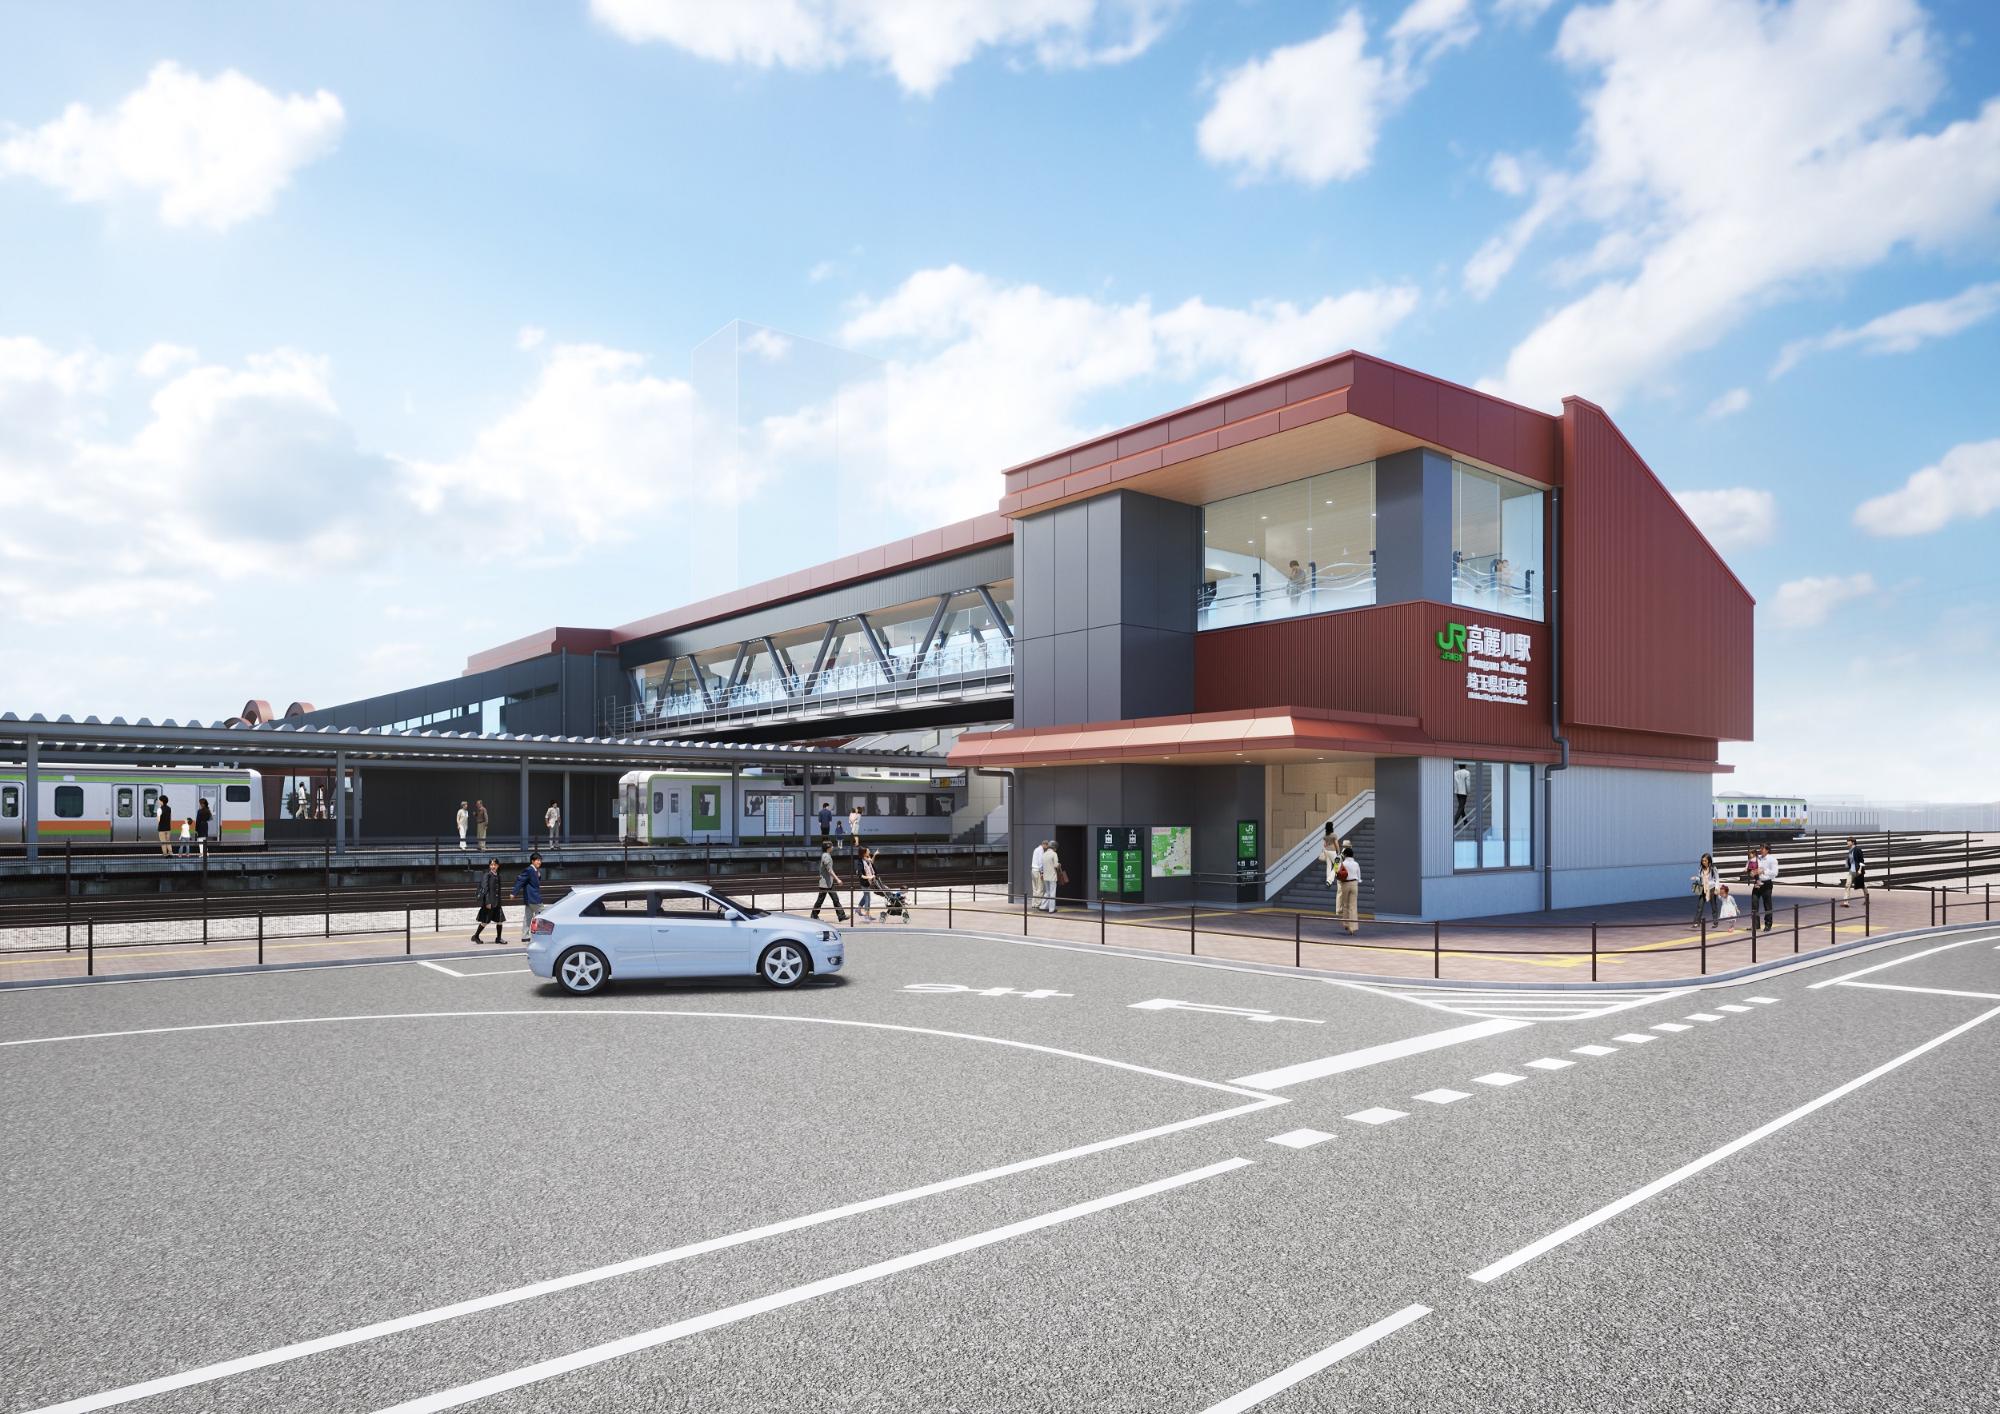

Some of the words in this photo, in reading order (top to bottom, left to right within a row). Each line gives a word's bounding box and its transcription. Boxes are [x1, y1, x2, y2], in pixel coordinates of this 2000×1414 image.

[1437, 622, 1466, 653] JR
[1466, 624, 1531, 661] 高麗川駅
